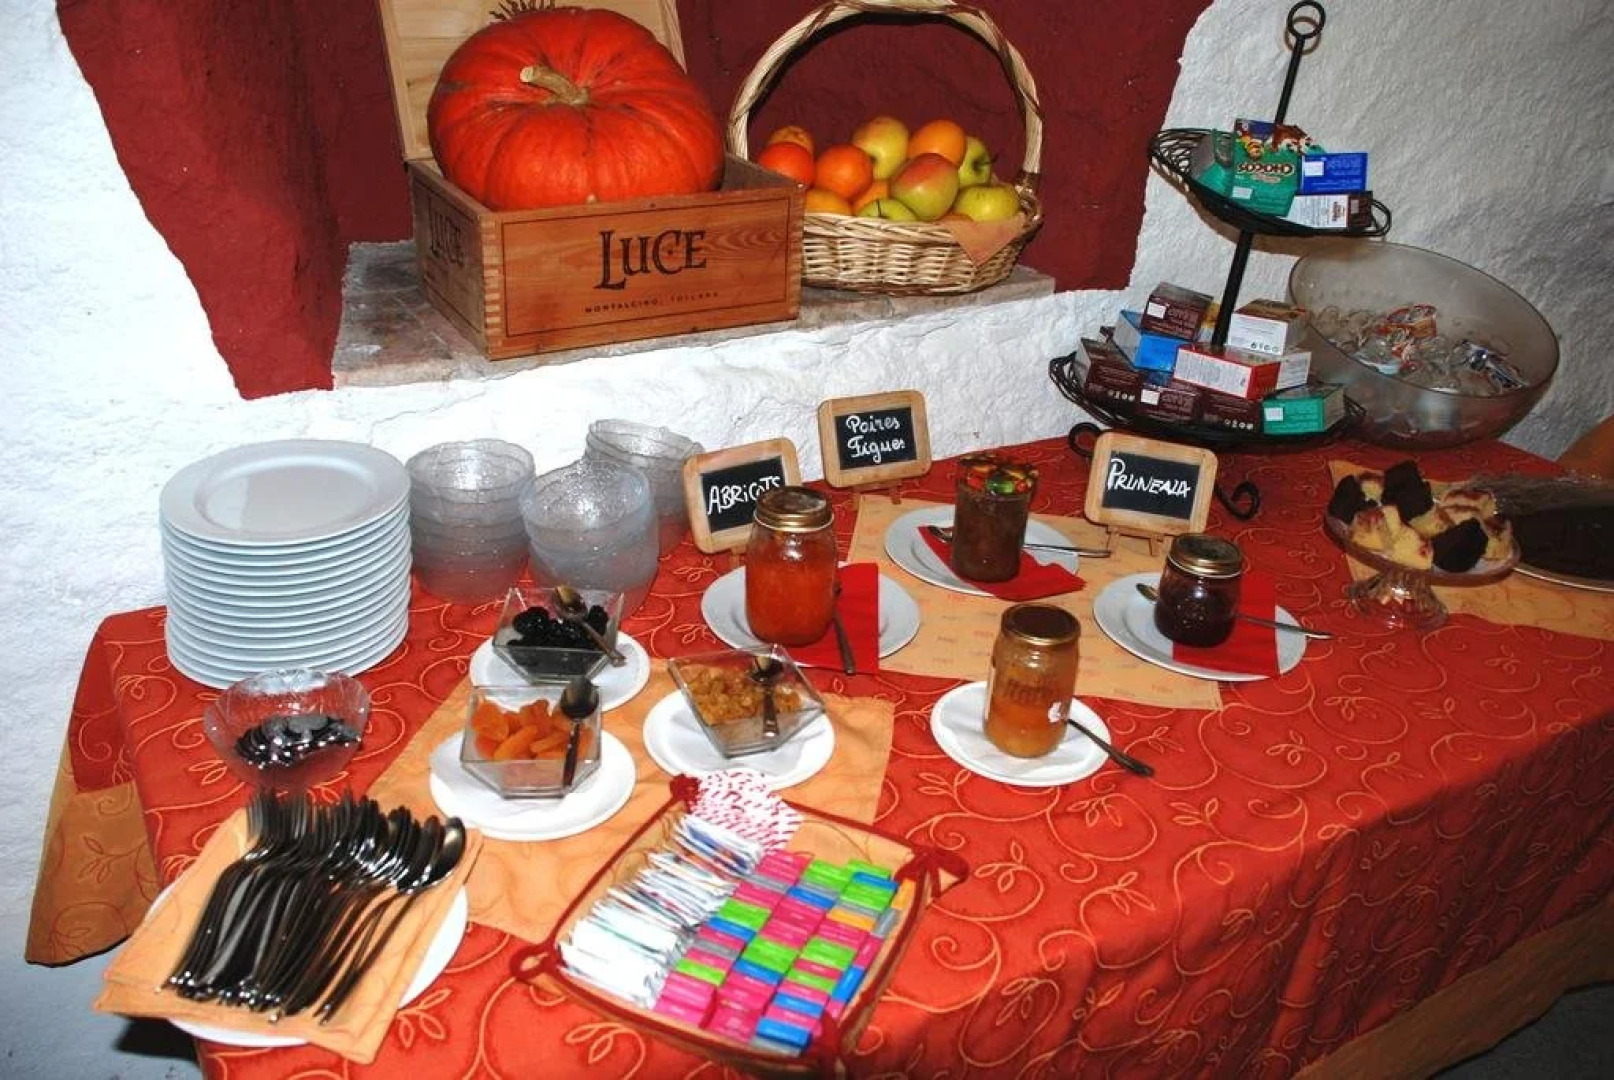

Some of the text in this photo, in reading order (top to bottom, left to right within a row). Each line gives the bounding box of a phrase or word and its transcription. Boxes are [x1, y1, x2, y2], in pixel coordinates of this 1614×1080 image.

[593, 229, 707, 291] LUCE
[845, 415, 901, 433] Poires
[847, 435, 906, 464] Figues
